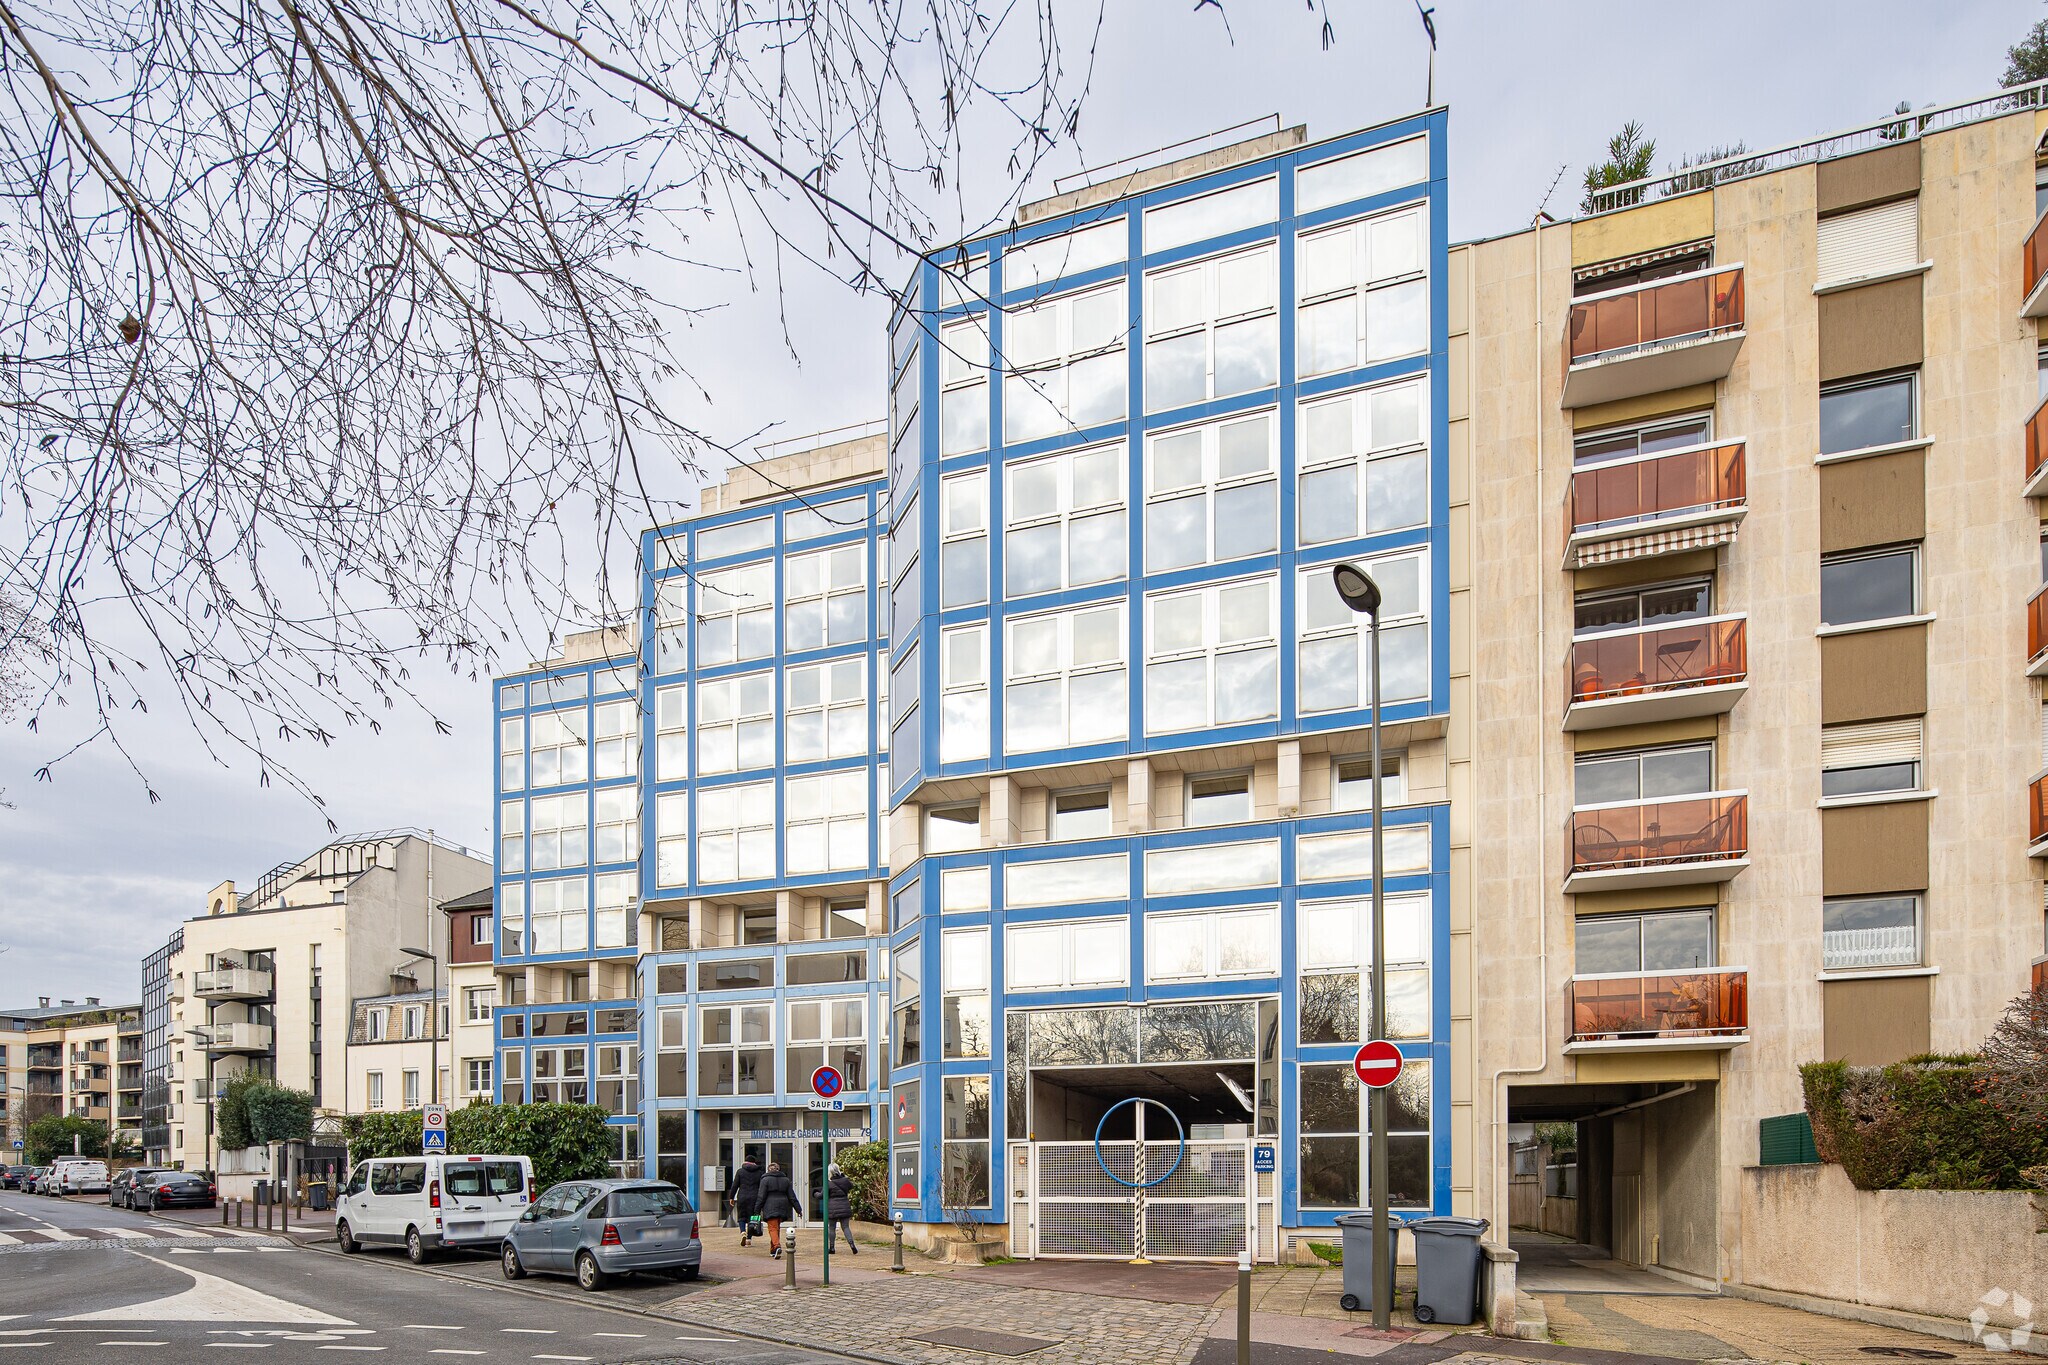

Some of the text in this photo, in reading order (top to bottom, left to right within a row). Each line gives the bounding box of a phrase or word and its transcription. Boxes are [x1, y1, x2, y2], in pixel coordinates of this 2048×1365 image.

[810, 1100, 832, 1108] SAUF
[751, 1129, 786, 1139] IMMEUBLE
[787, 1129, 796, 1139] LE
[797, 1128, 825, 1139] GABRIE
[860, 1127, 872, 1137] 79
[1258, 1150, 1271, 1158] 79
